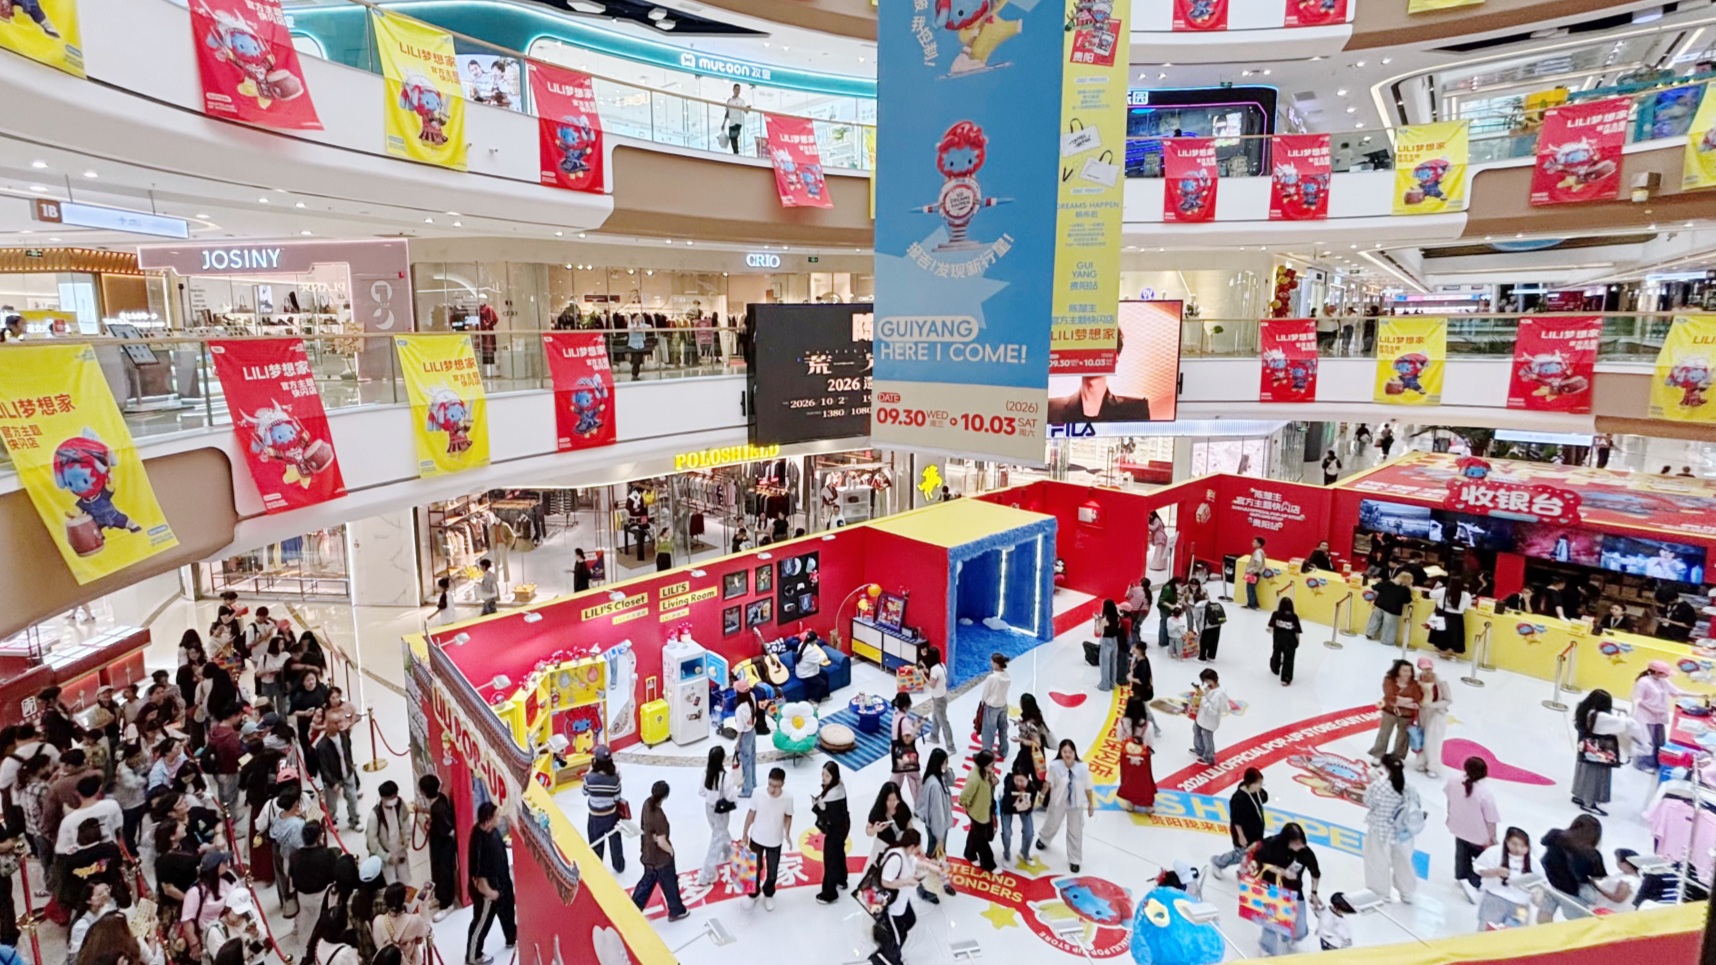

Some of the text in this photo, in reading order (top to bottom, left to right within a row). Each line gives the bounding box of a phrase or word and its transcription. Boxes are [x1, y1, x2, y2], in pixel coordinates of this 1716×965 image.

[699, 58, 750, 77] mutoon
[40, 204, 59, 218] 1B
[202, 248, 281, 270] JOSINY
[746, 254, 781, 268] CRIO
[1076, 261, 1094, 270] GUI
[1071, 270, 1097, 279] YANG
[880, 319, 974, 339] GUIYANG
[1051, 328, 1116, 341] LILI梦想家
[880, 342, 1028, 364] HERE I COME!
[242, 361, 311, 381] LILI梦想家
[423, 357, 477, 373] LILI梦想家
[827, 377, 861, 392] 2026
[878, 393, 901, 403] DATE
[822, 408, 845, 418] 1380
[1005, 400, 1039, 414] (2026)
[876, 407, 1038, 436] 09.30 WED 10.03 SAT
[929, 419, 945, 428] 周三
[1, 424, 43, 439] 官方主题
[1018, 428, 1036, 437] 周六
[1051, 423, 1096, 437] FILA
[674, 444, 780, 470] POLOSHIELD
[1459, 485, 1565, 517] 收银台
[662, 583, 687, 597] LILI'S
[584, 604, 613, 620] LILI'S
[614, 594, 646, 611] Closet
[662, 590, 715, 610] Living Room
[454, 715, 507, 806] POP-UP
[1177, 776, 1210, 793] 2026
[1219, 744, 1269, 771] OFFICIAL
[1262, 730, 1306, 751] POP-UP
[1302, 720, 1337, 738] STORE
[948, 873, 1024, 903] ONDERS
